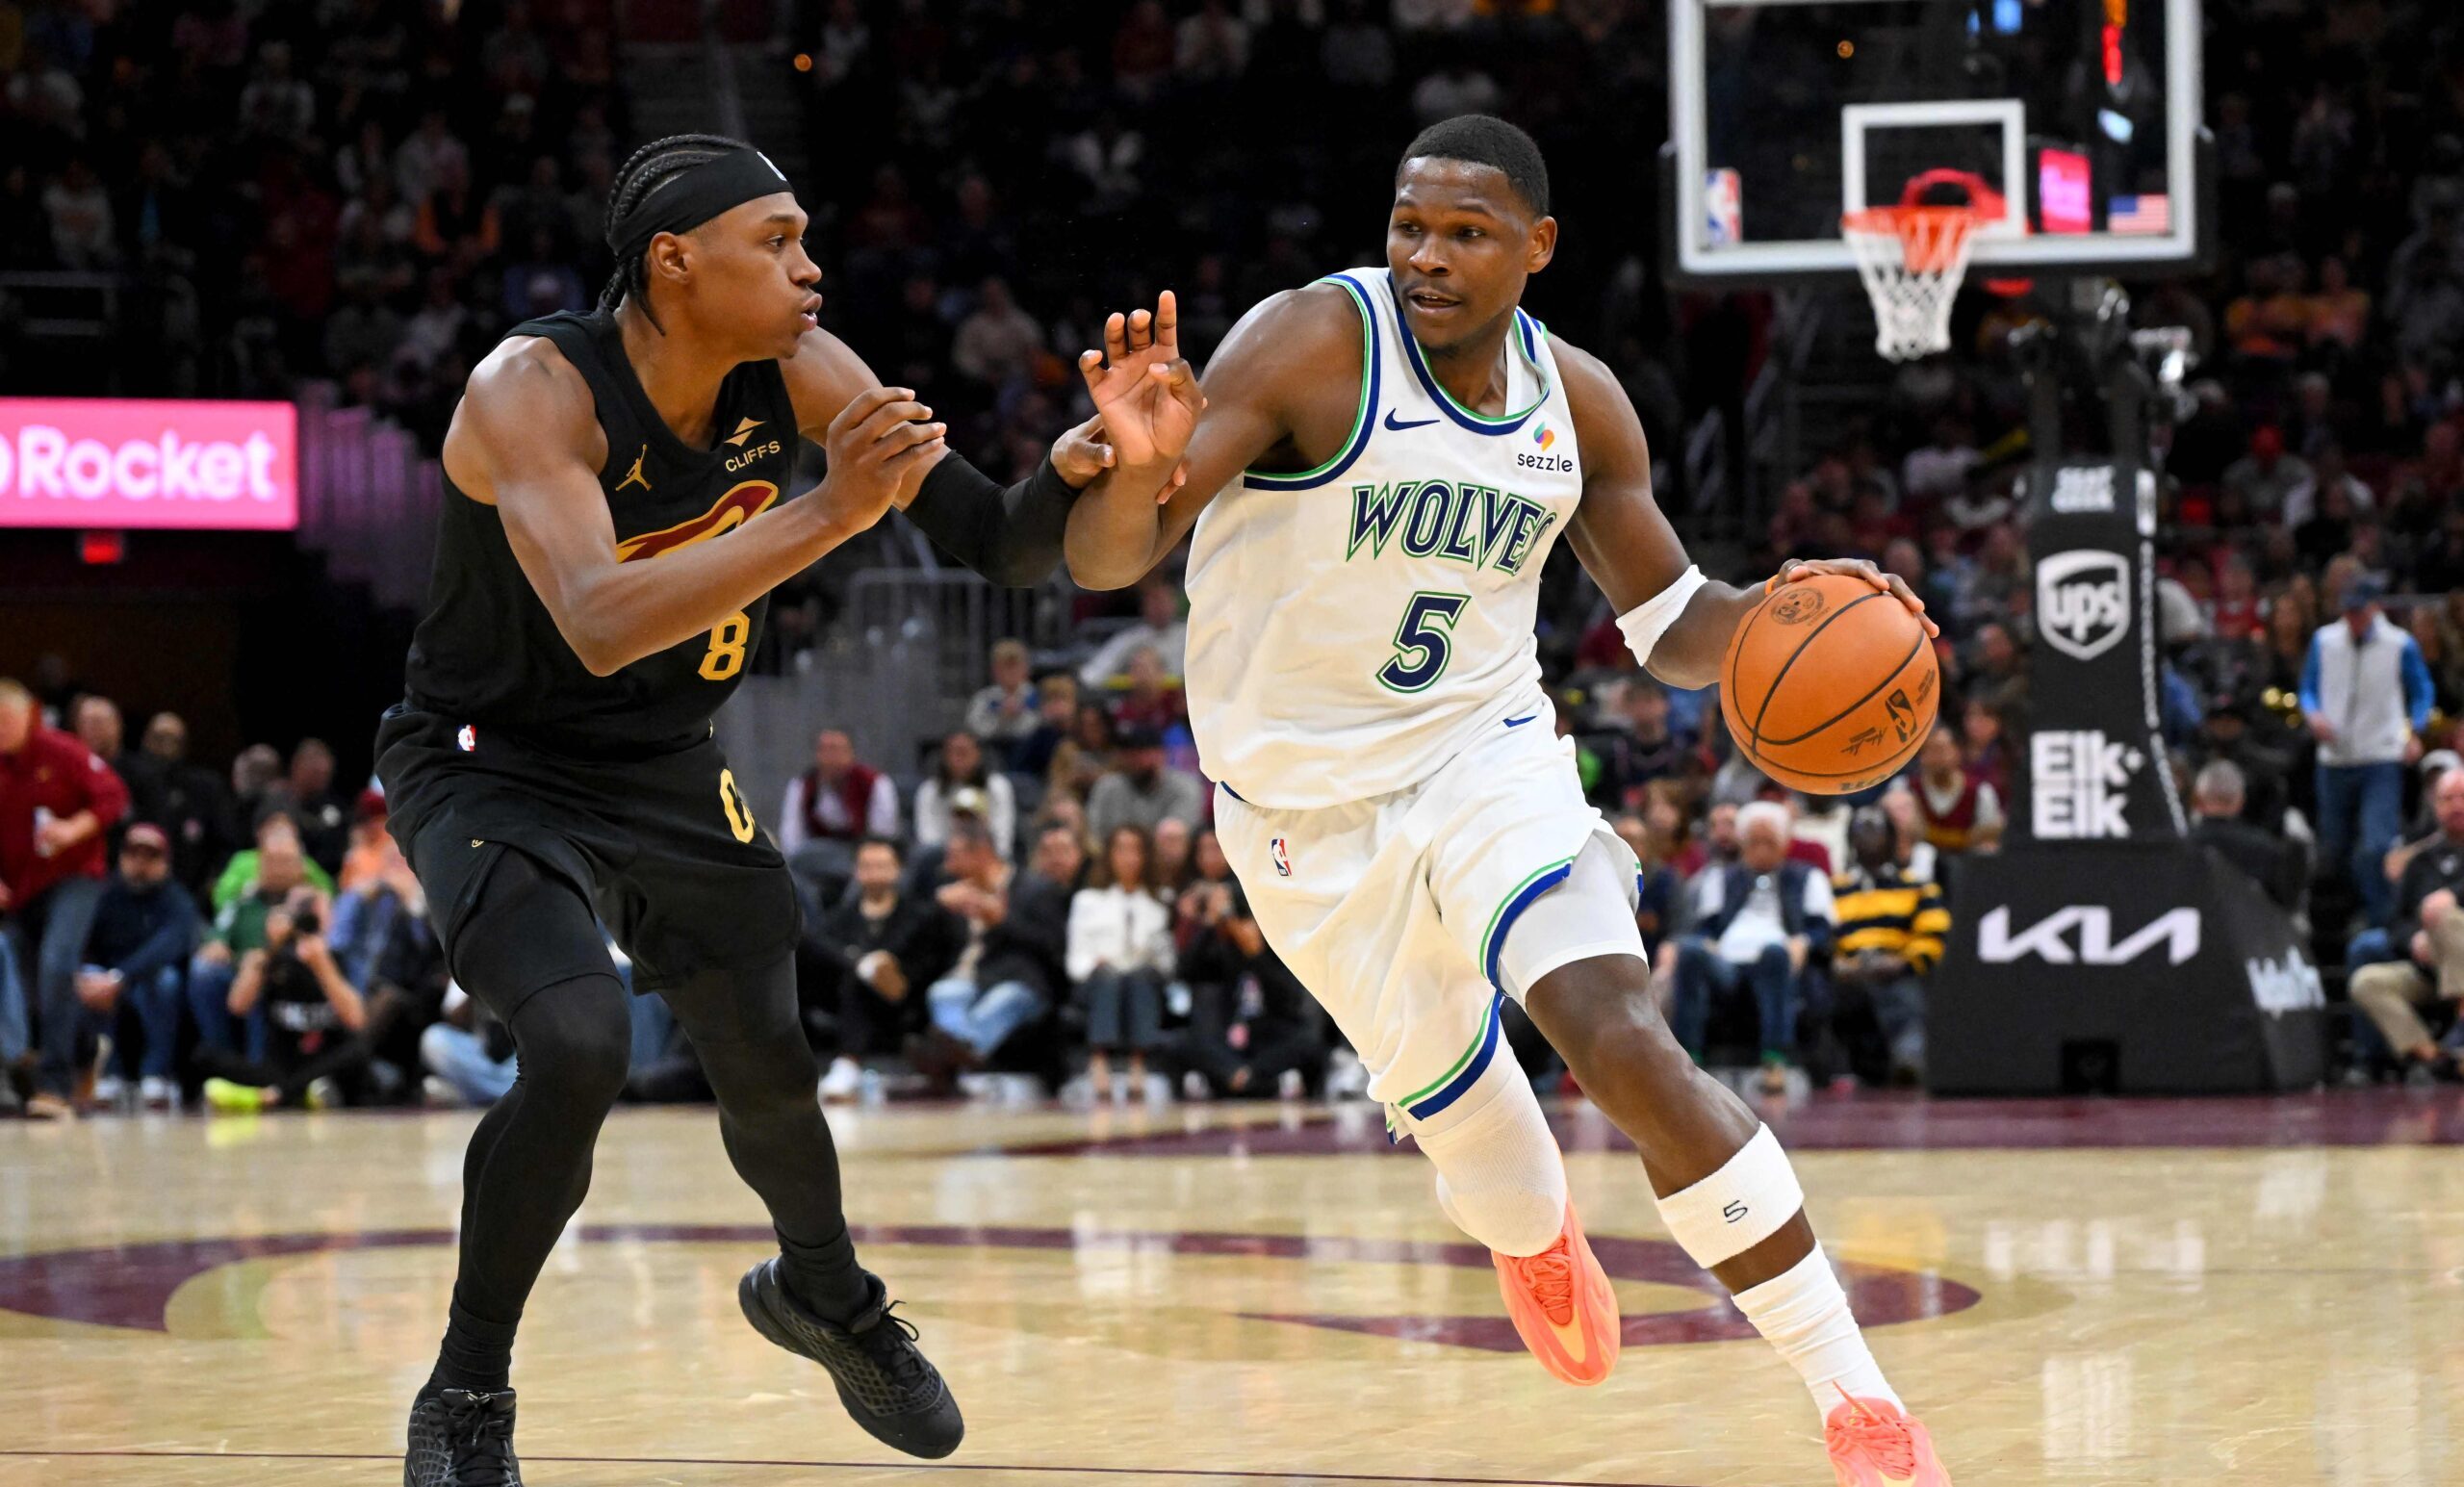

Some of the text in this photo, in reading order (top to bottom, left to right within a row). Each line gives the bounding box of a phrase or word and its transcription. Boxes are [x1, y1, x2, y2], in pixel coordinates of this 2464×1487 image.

[18, 423, 276, 501] Rocket
[725, 440, 781, 473] CLIFFS
[1517, 452, 1573, 473] sezzle
[2045, 581, 2127, 643] ups
[698, 609, 751, 680] 8
[1375, 591, 1472, 694] 5
[2031, 786, 2132, 839] Elk
[1723, 1199, 1748, 1223] 5
